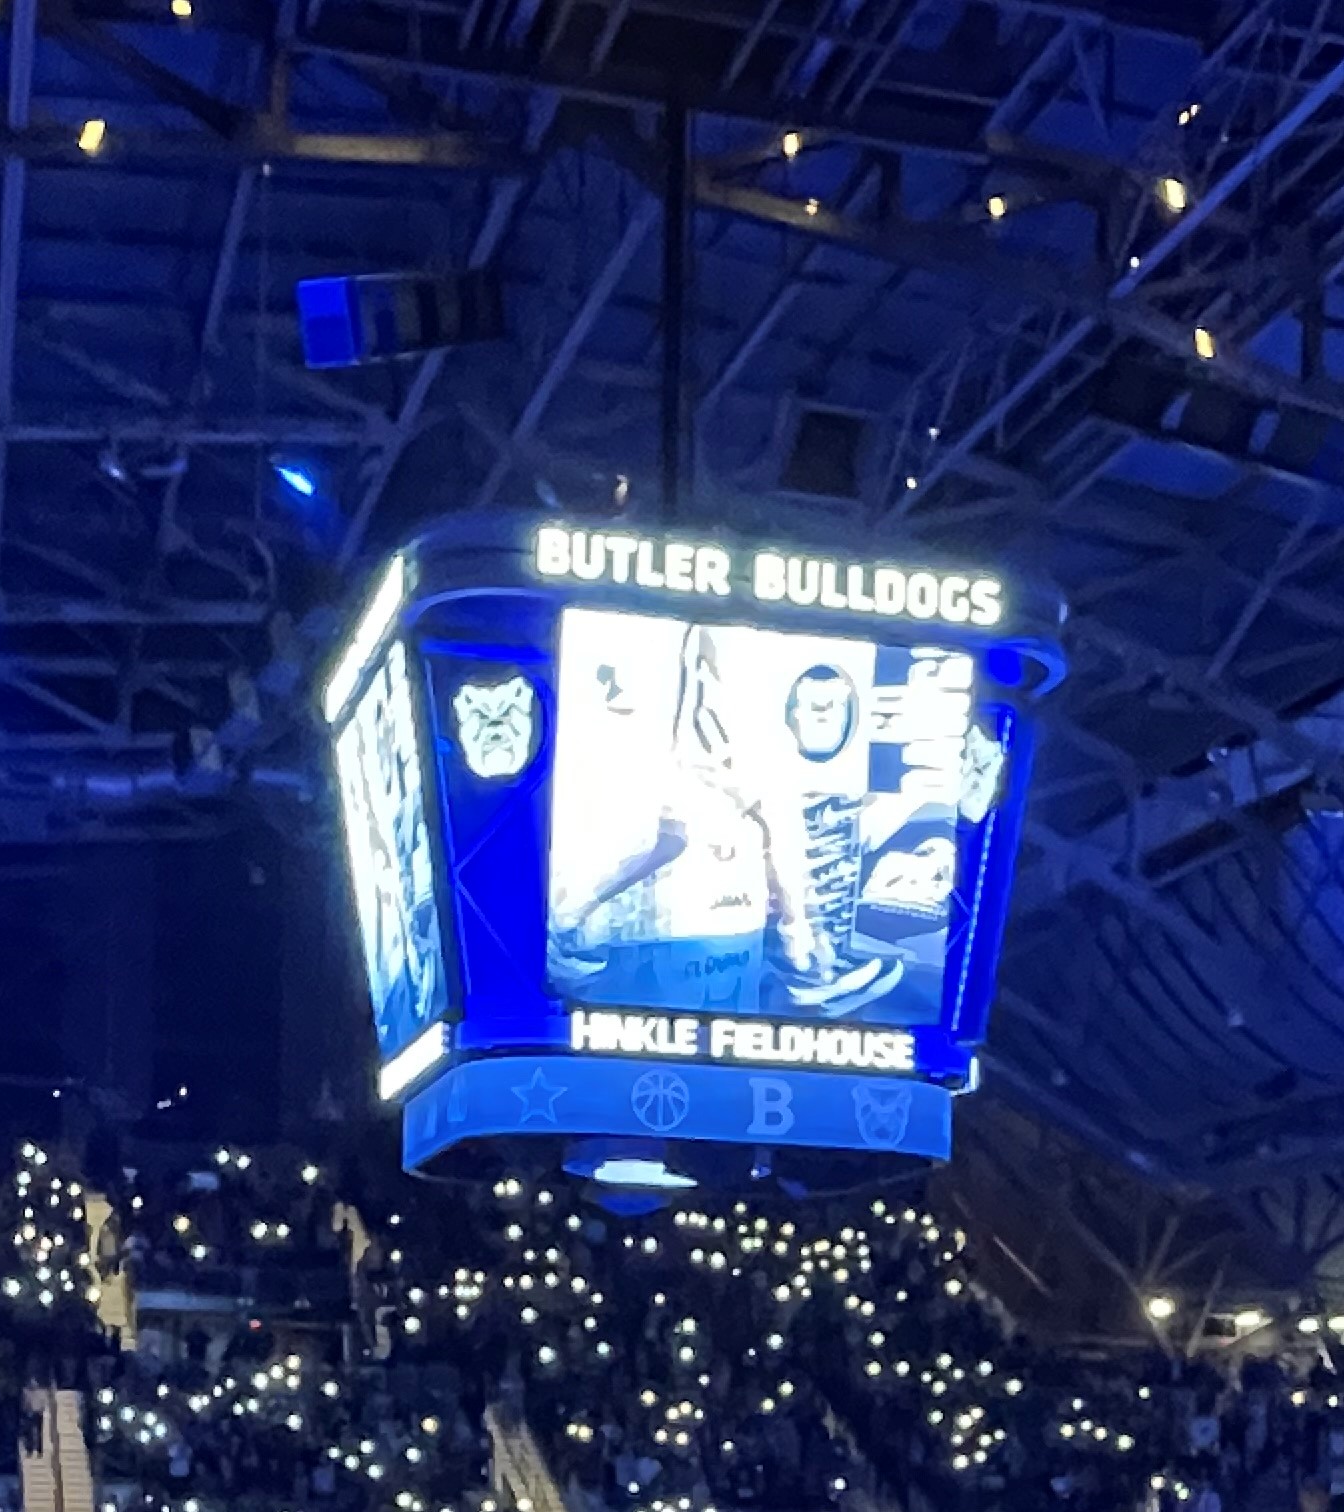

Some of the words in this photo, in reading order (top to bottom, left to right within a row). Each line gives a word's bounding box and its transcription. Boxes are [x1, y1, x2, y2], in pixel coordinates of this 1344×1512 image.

[537, 527, 731, 596] BUTLER
[754, 552, 1001, 626] BULLDOGS
[571, 1010, 698, 1055] HINKLE
[711, 1019, 915, 1070] FIELDHOUSE
[746, 1077, 795, 1135] B
